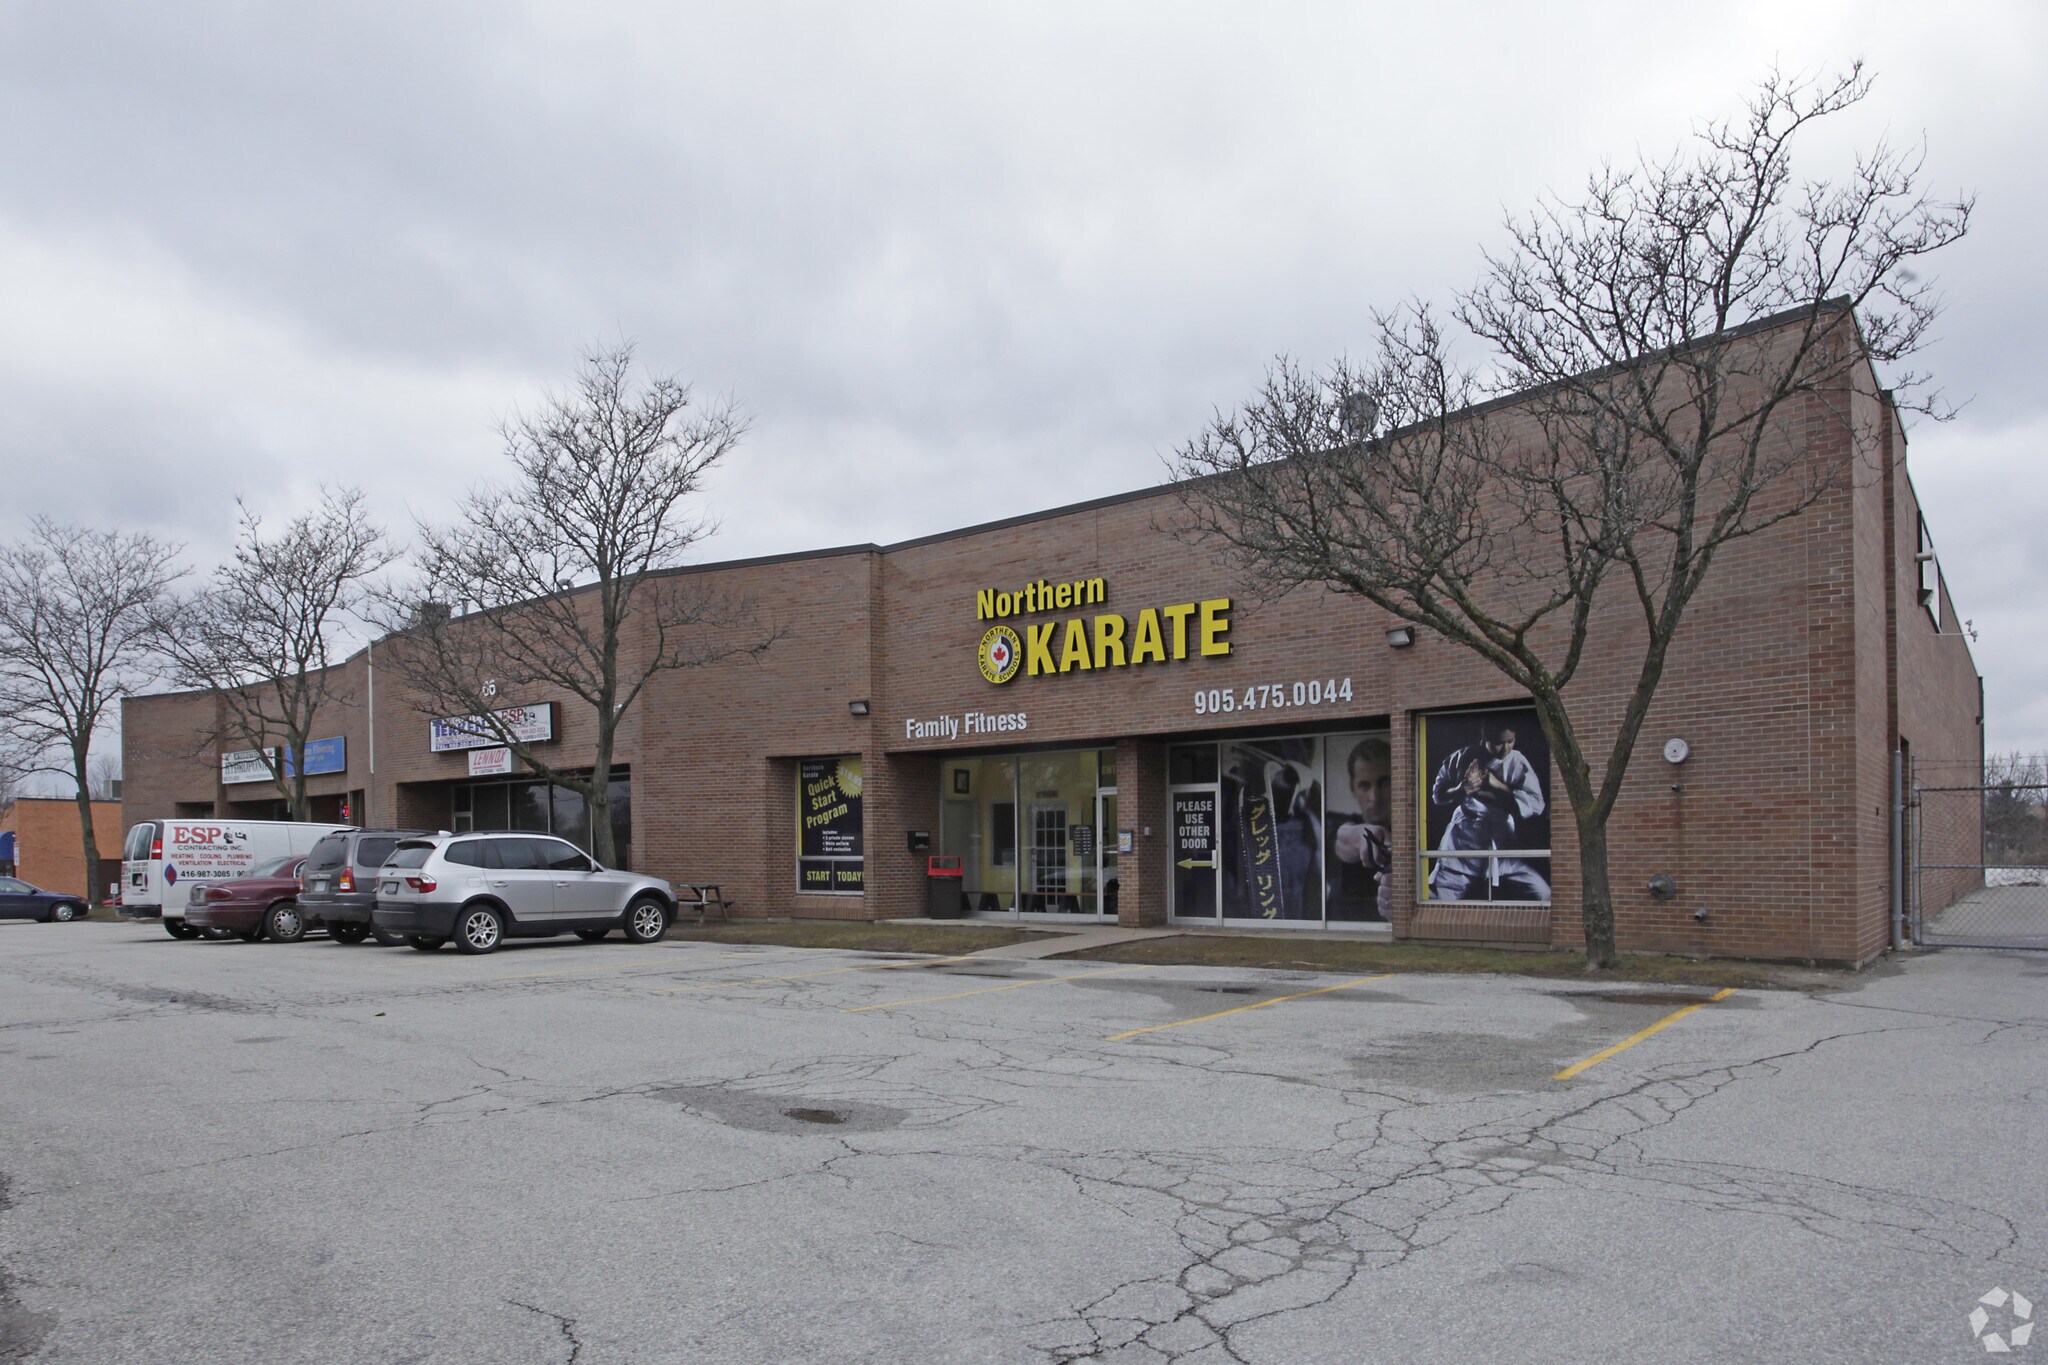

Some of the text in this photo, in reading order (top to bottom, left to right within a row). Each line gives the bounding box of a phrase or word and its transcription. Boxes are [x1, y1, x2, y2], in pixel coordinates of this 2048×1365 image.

[977, 577, 1104, 620] Northern
[982, 627, 1017, 647] NORTHERN
[1027, 598, 1230, 676] KARATE
[979, 651, 1020, 682] KARATE SCHOOLS
[1194, 677, 1353, 715] 905.475.0044
[906, 712, 1027, 740] Family Fitness
[473, 748, 508, 766] LENNOX
[807, 775, 836, 797] Quick
[811, 790, 837, 811] Start
[1176, 801, 1213, 812] PLEASE
[806, 803, 848, 829] Program
[1185, 814, 1204, 824] USE
[173, 827, 222, 844] ESP
[1179, 826, 1210, 837] OTHER
[1181, 839, 1208, 849] DOOR
[806, 870, 831, 881] START
